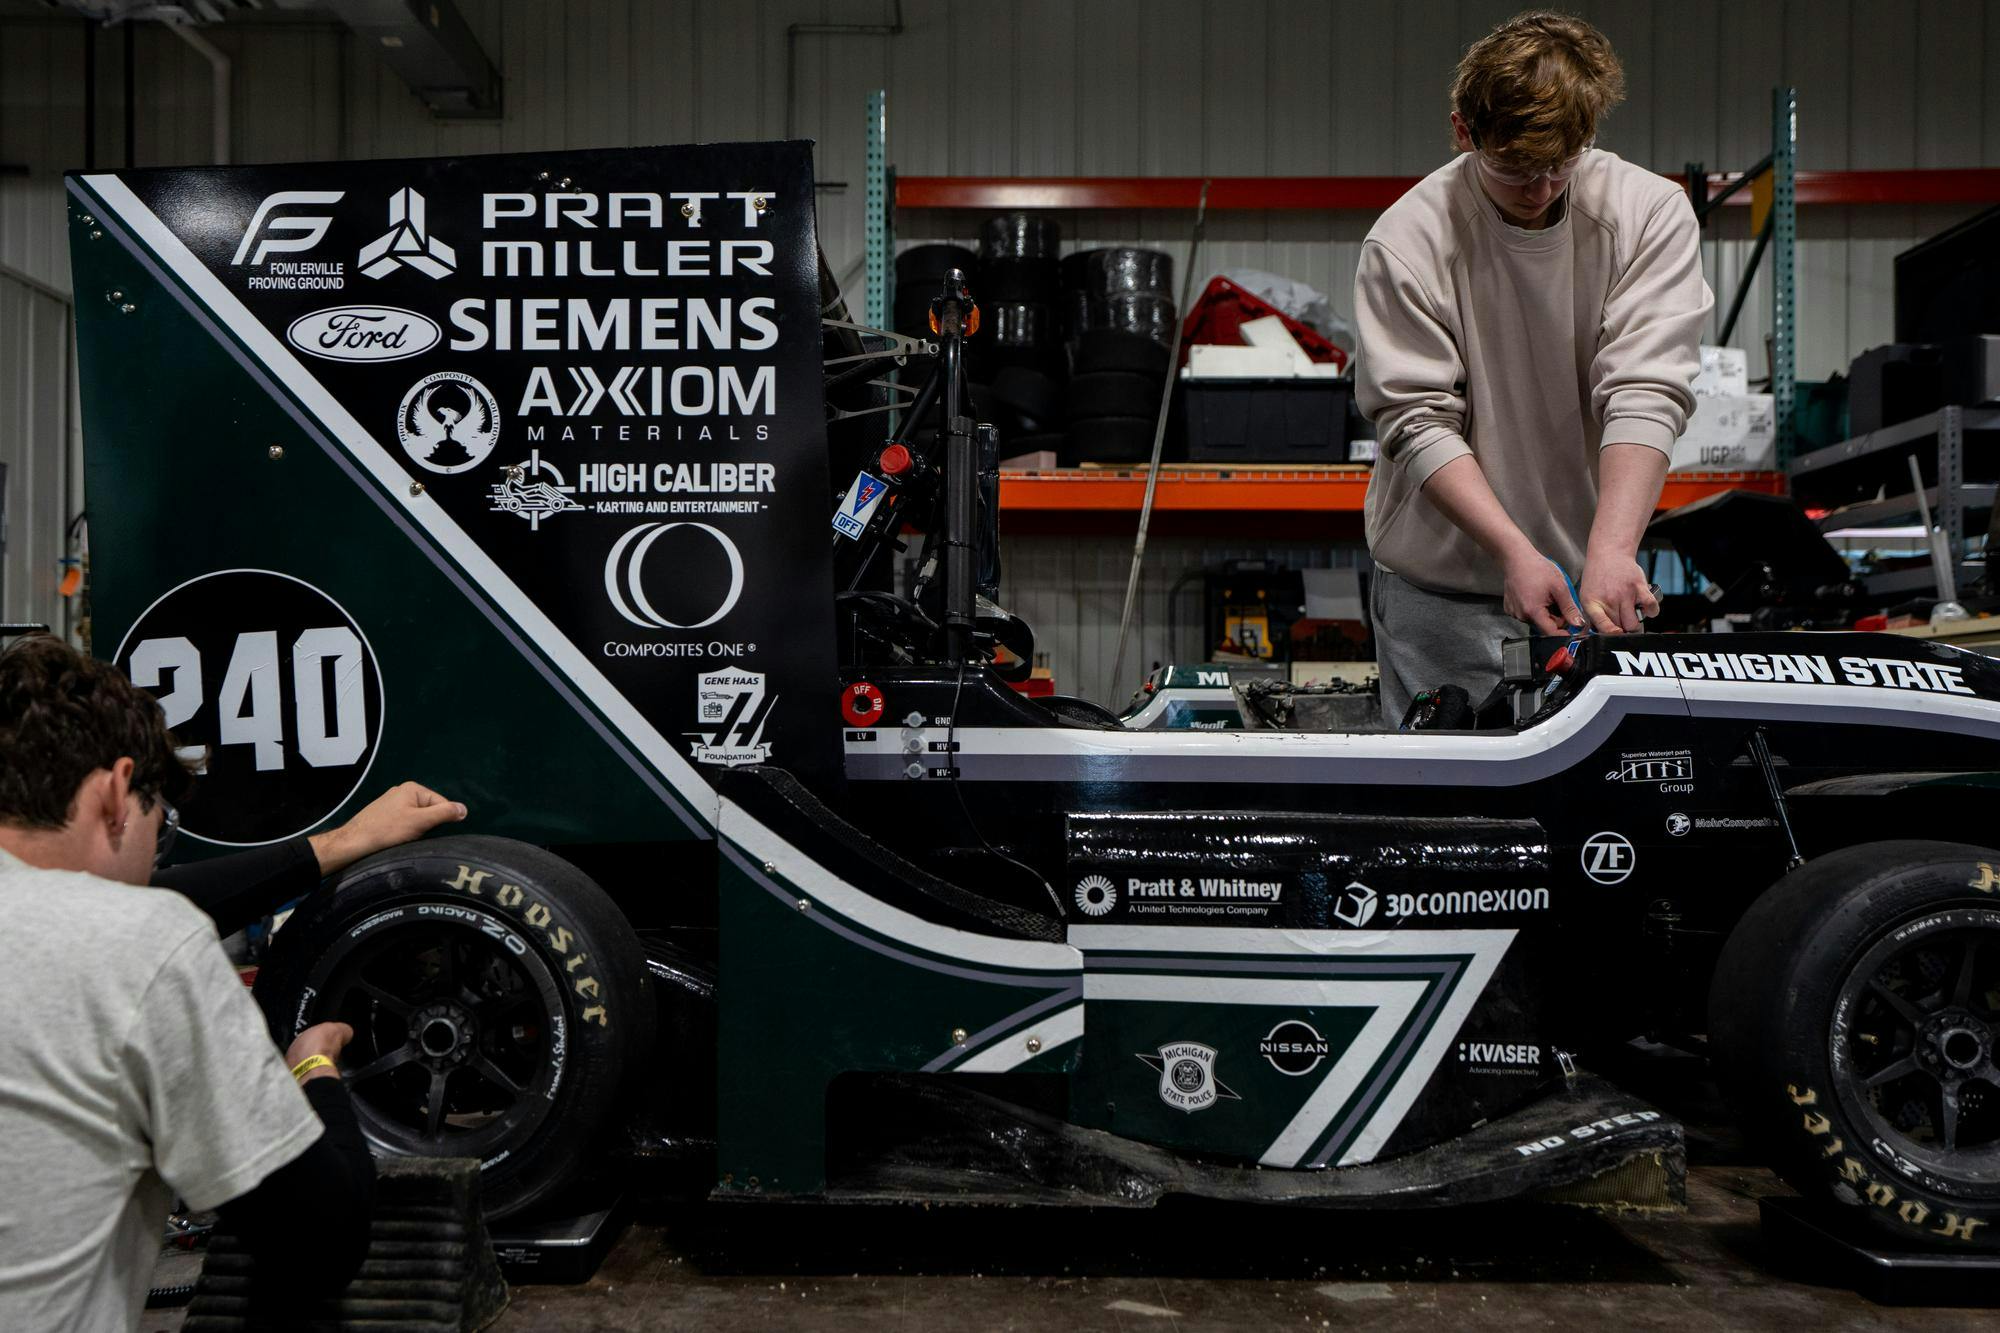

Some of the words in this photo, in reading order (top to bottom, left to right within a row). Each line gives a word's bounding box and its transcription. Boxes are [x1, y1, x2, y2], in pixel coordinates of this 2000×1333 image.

[482, 192, 776, 229] PRATT
[482, 240, 776, 277] MILLER
[270, 263, 345, 275] FOWLERVILLE
[249, 277, 297, 290] PROVING
[297, 277, 345, 290] GROUND
[318, 314, 409, 349] Ford
[448, 297, 779, 351] SIEMENS
[517, 365, 776, 416] AXIOM
[527, 425, 769, 442] MATERIALS
[579, 463, 647, 493] HIGH
[653, 463, 776, 493] CALIBER
[645, 501, 668, 514] AND
[838, 516, 858, 532] OFF
[704, 677, 731, 685] GENE
[732, 677, 760, 685] HAAS
[1610, 650, 1836, 685] MICHIGAN
[1837, 656, 1977, 695] STATE
[853, 685, 871, 695] OFF
[129, 625, 369, 776] 240
[872, 698, 882, 711] ON
[935, 717, 951, 725] GND
[704, 753, 757, 761] FOUNDATION
[1659, 782, 1694, 794] Group
[1588, 843, 1630, 874] ZF
[1127, 878, 1176, 897] Pratt
[1179, 878, 1196, 897] &
[1199, 878, 1283, 901] Whitney
[1129, 905, 1137, 914] A
[1138, 905, 1166, 914] United
[1169, 905, 1225, 916] Technologies
[1226, 905, 1269, 916] Company
[1385, 887, 1550, 918] 3Dconnexion
[417, 905, 477, 922] RACING
[1164, 1047, 1212, 1063] MICHIGAN
[1260, 1042, 1329, 1054] NISSAN
[1469, 1043, 1540, 1064] KVASER
[1163, 1087, 1185, 1104] STATE
[1188, 1089, 1214, 1105] POLICE
[1514, 1135, 1566, 1157] NO
